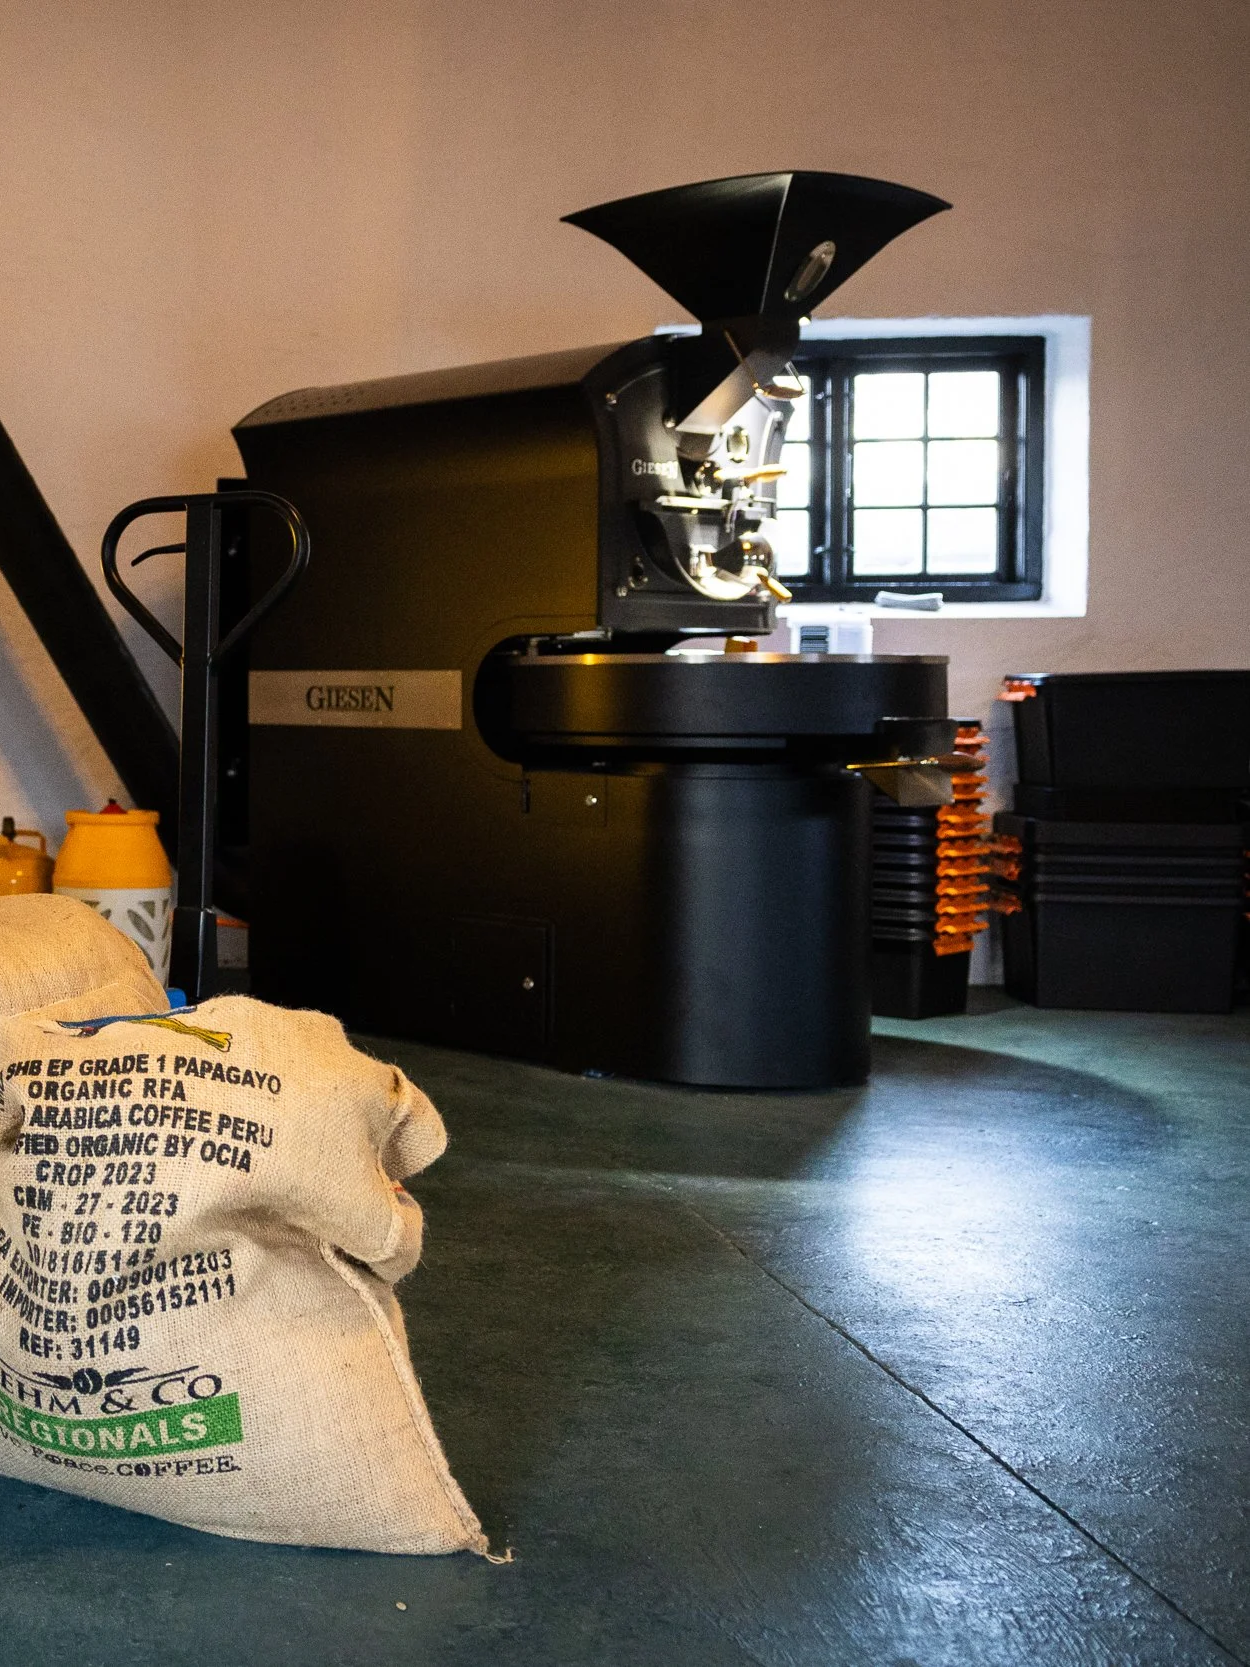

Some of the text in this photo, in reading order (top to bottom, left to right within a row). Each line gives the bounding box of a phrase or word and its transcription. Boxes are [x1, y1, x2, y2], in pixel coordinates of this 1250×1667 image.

[305, 685, 394, 711] GIESEN
[6, 1060, 43, 1080] SHB
[47, 1059, 73, 1077] EP
[79, 1054, 149, 1077] GRADE
[157, 1055, 166, 1073] 1
[174, 1055, 282, 1095] PAPAGAYO
[28, 1078, 186, 1101] ORGANIC RFA
[29, 1104, 121, 1130] ARABICA
[128, 1103, 211, 1133] COFFEE
[217, 1114, 274, 1148] PERU
[66, 1132, 159, 1158] ORGANIC
[164, 1133, 196, 1158] BY
[200, 1139, 251, 1173] OCIA
[35, 1160, 156, 1187] CROP 2023
[14, 1186, 53, 1212] CRM
[75, 1192, 101, 1215] 27
[121, 1190, 179, 1218] 2023
[22, 1213, 42, 1239] PE
[60, 1221, 98, 1246] BIO
[121, 1220, 162, 1244] 120
[10, 1249, 78, 1304] EXPORTER:
[87, 1248, 232, 1303] 00090012203
[86, 1273, 236, 1329] 00056152111
[19, 1325, 140, 1360] REF: 31149
[100, 1388, 137, 1415] &
[151, 1374, 222, 1406] CO
